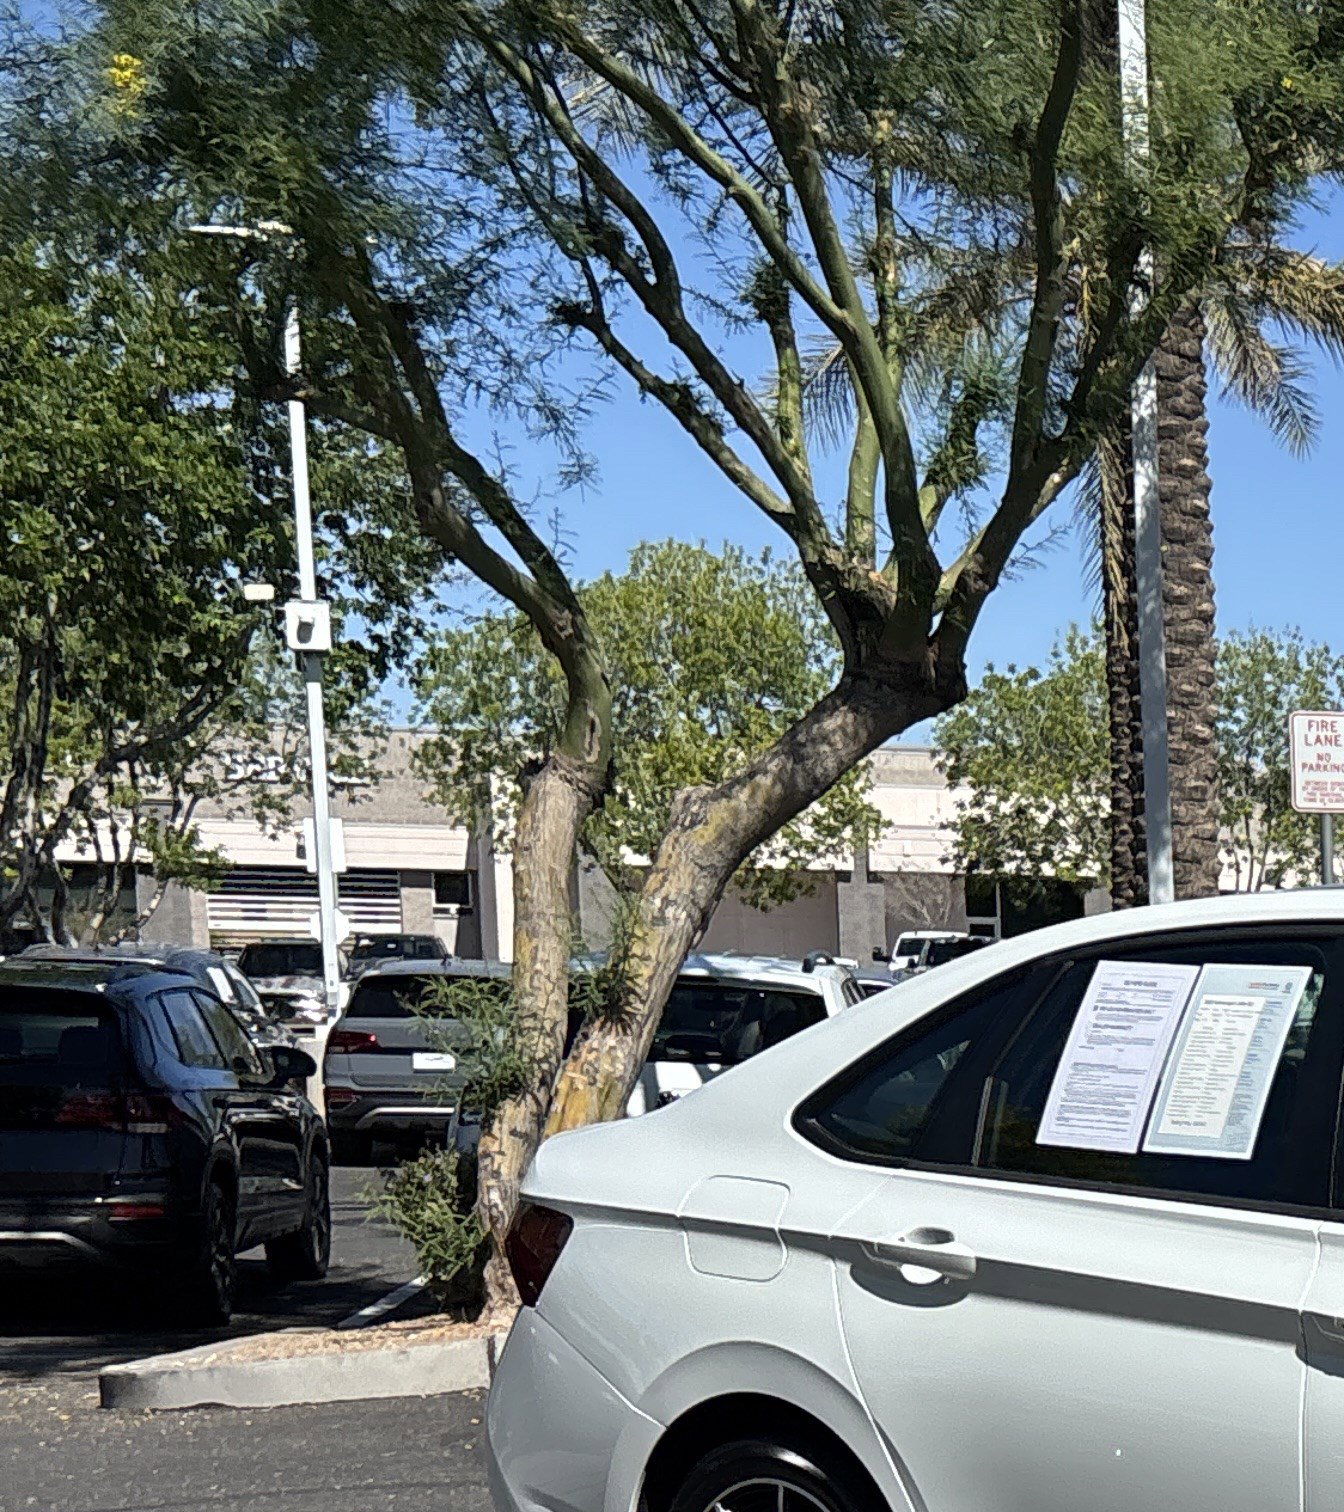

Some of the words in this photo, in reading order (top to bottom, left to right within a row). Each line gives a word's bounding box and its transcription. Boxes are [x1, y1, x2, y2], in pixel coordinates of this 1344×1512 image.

[1307, 719, 1338, 733] FIRE
[1304, 733, 1343, 747] LANE
[1316, 752, 1332, 763] NO
